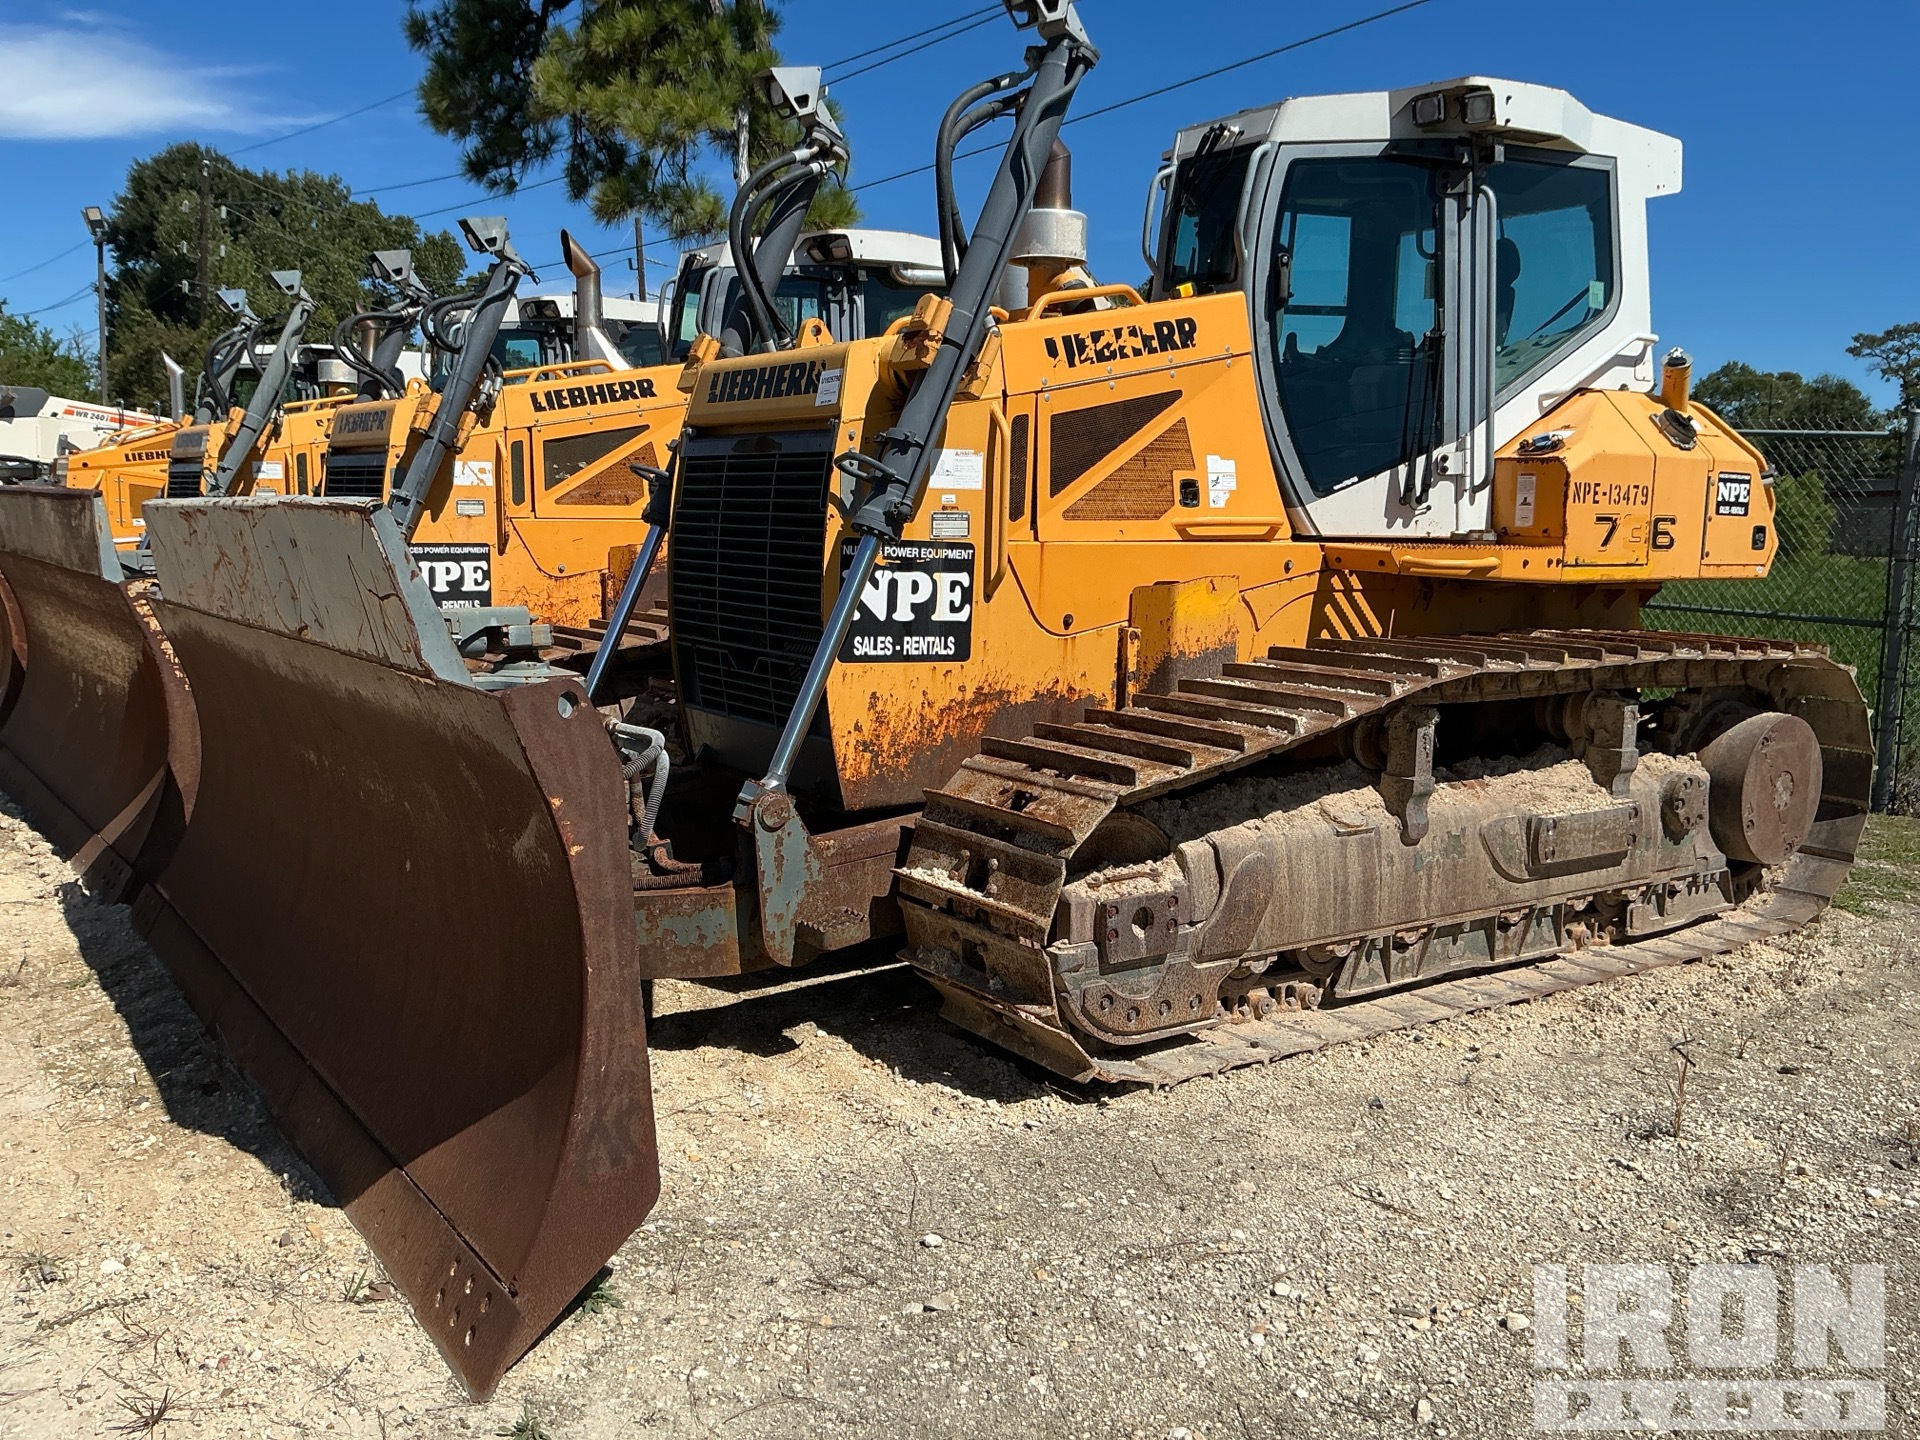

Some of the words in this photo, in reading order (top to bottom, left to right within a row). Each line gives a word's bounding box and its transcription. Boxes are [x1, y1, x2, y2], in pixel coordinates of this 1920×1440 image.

[529, 378, 657, 413] LIEBHERR
[75, 410, 89, 418] WR
[1572, 482, 1649, 506] NPE-13479
[1717, 482, 1750, 503] NPE
[424, 546, 450, 554] POWER
[884, 546, 919, 558] POWER
[920, 548, 974, 560] EQUIPMENT
[853, 636, 893, 656] SALES
[903, 636, 955, 656] RENTALS
